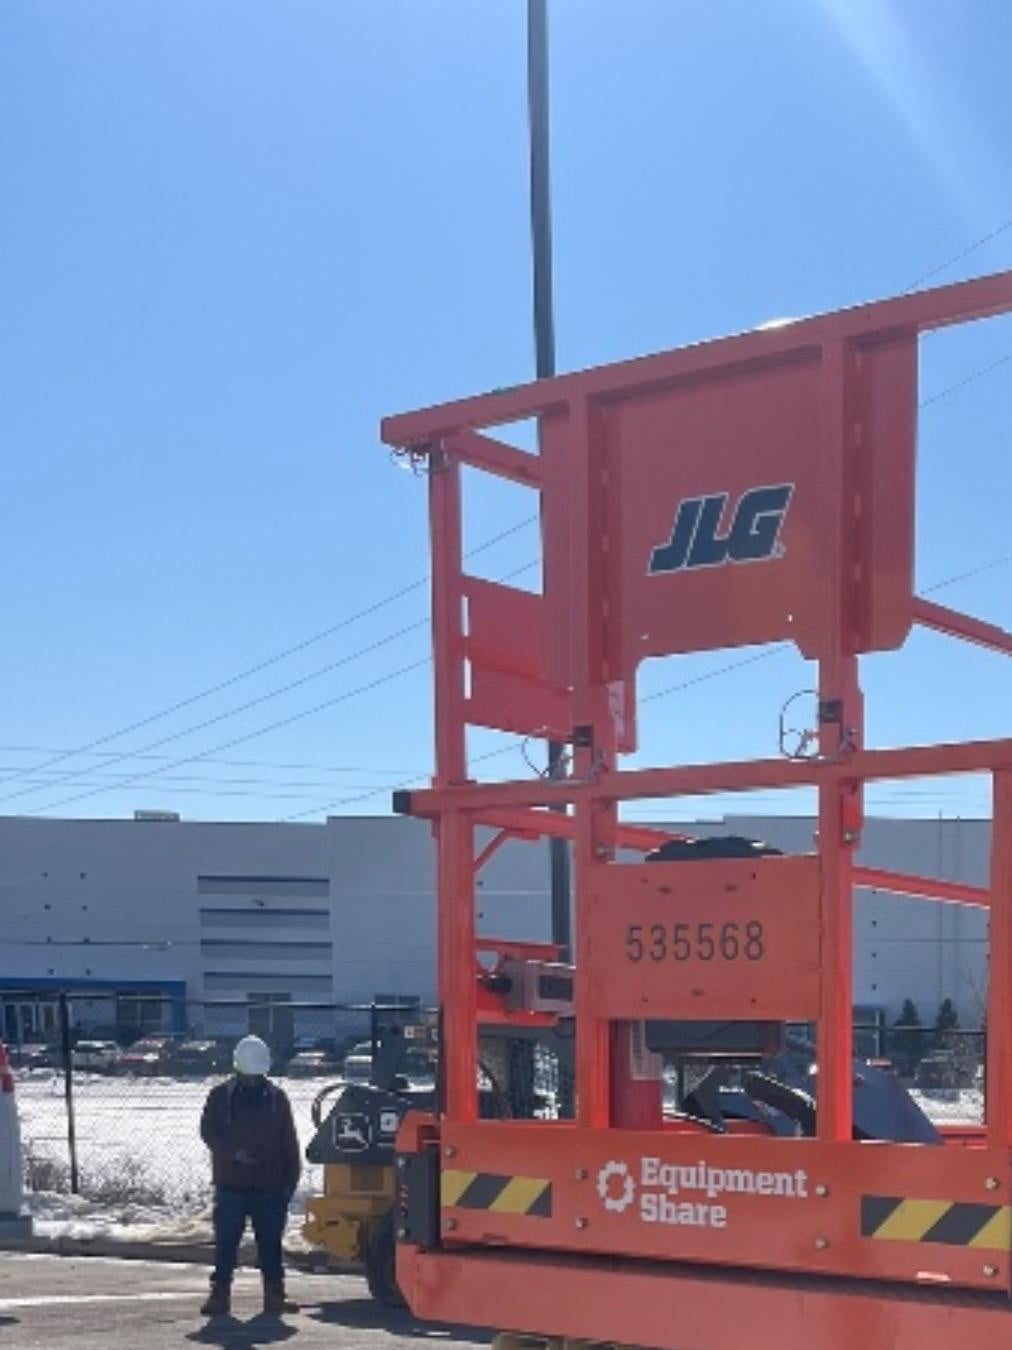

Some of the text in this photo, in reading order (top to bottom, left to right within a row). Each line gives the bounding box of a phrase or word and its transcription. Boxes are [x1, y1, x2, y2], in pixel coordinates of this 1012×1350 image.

[647, 483, 795, 576] JLG
[625, 921, 764, 963] 535568
[640, 1156, 808, 1199] Equipment
[640, 1198, 727, 1228] Share
